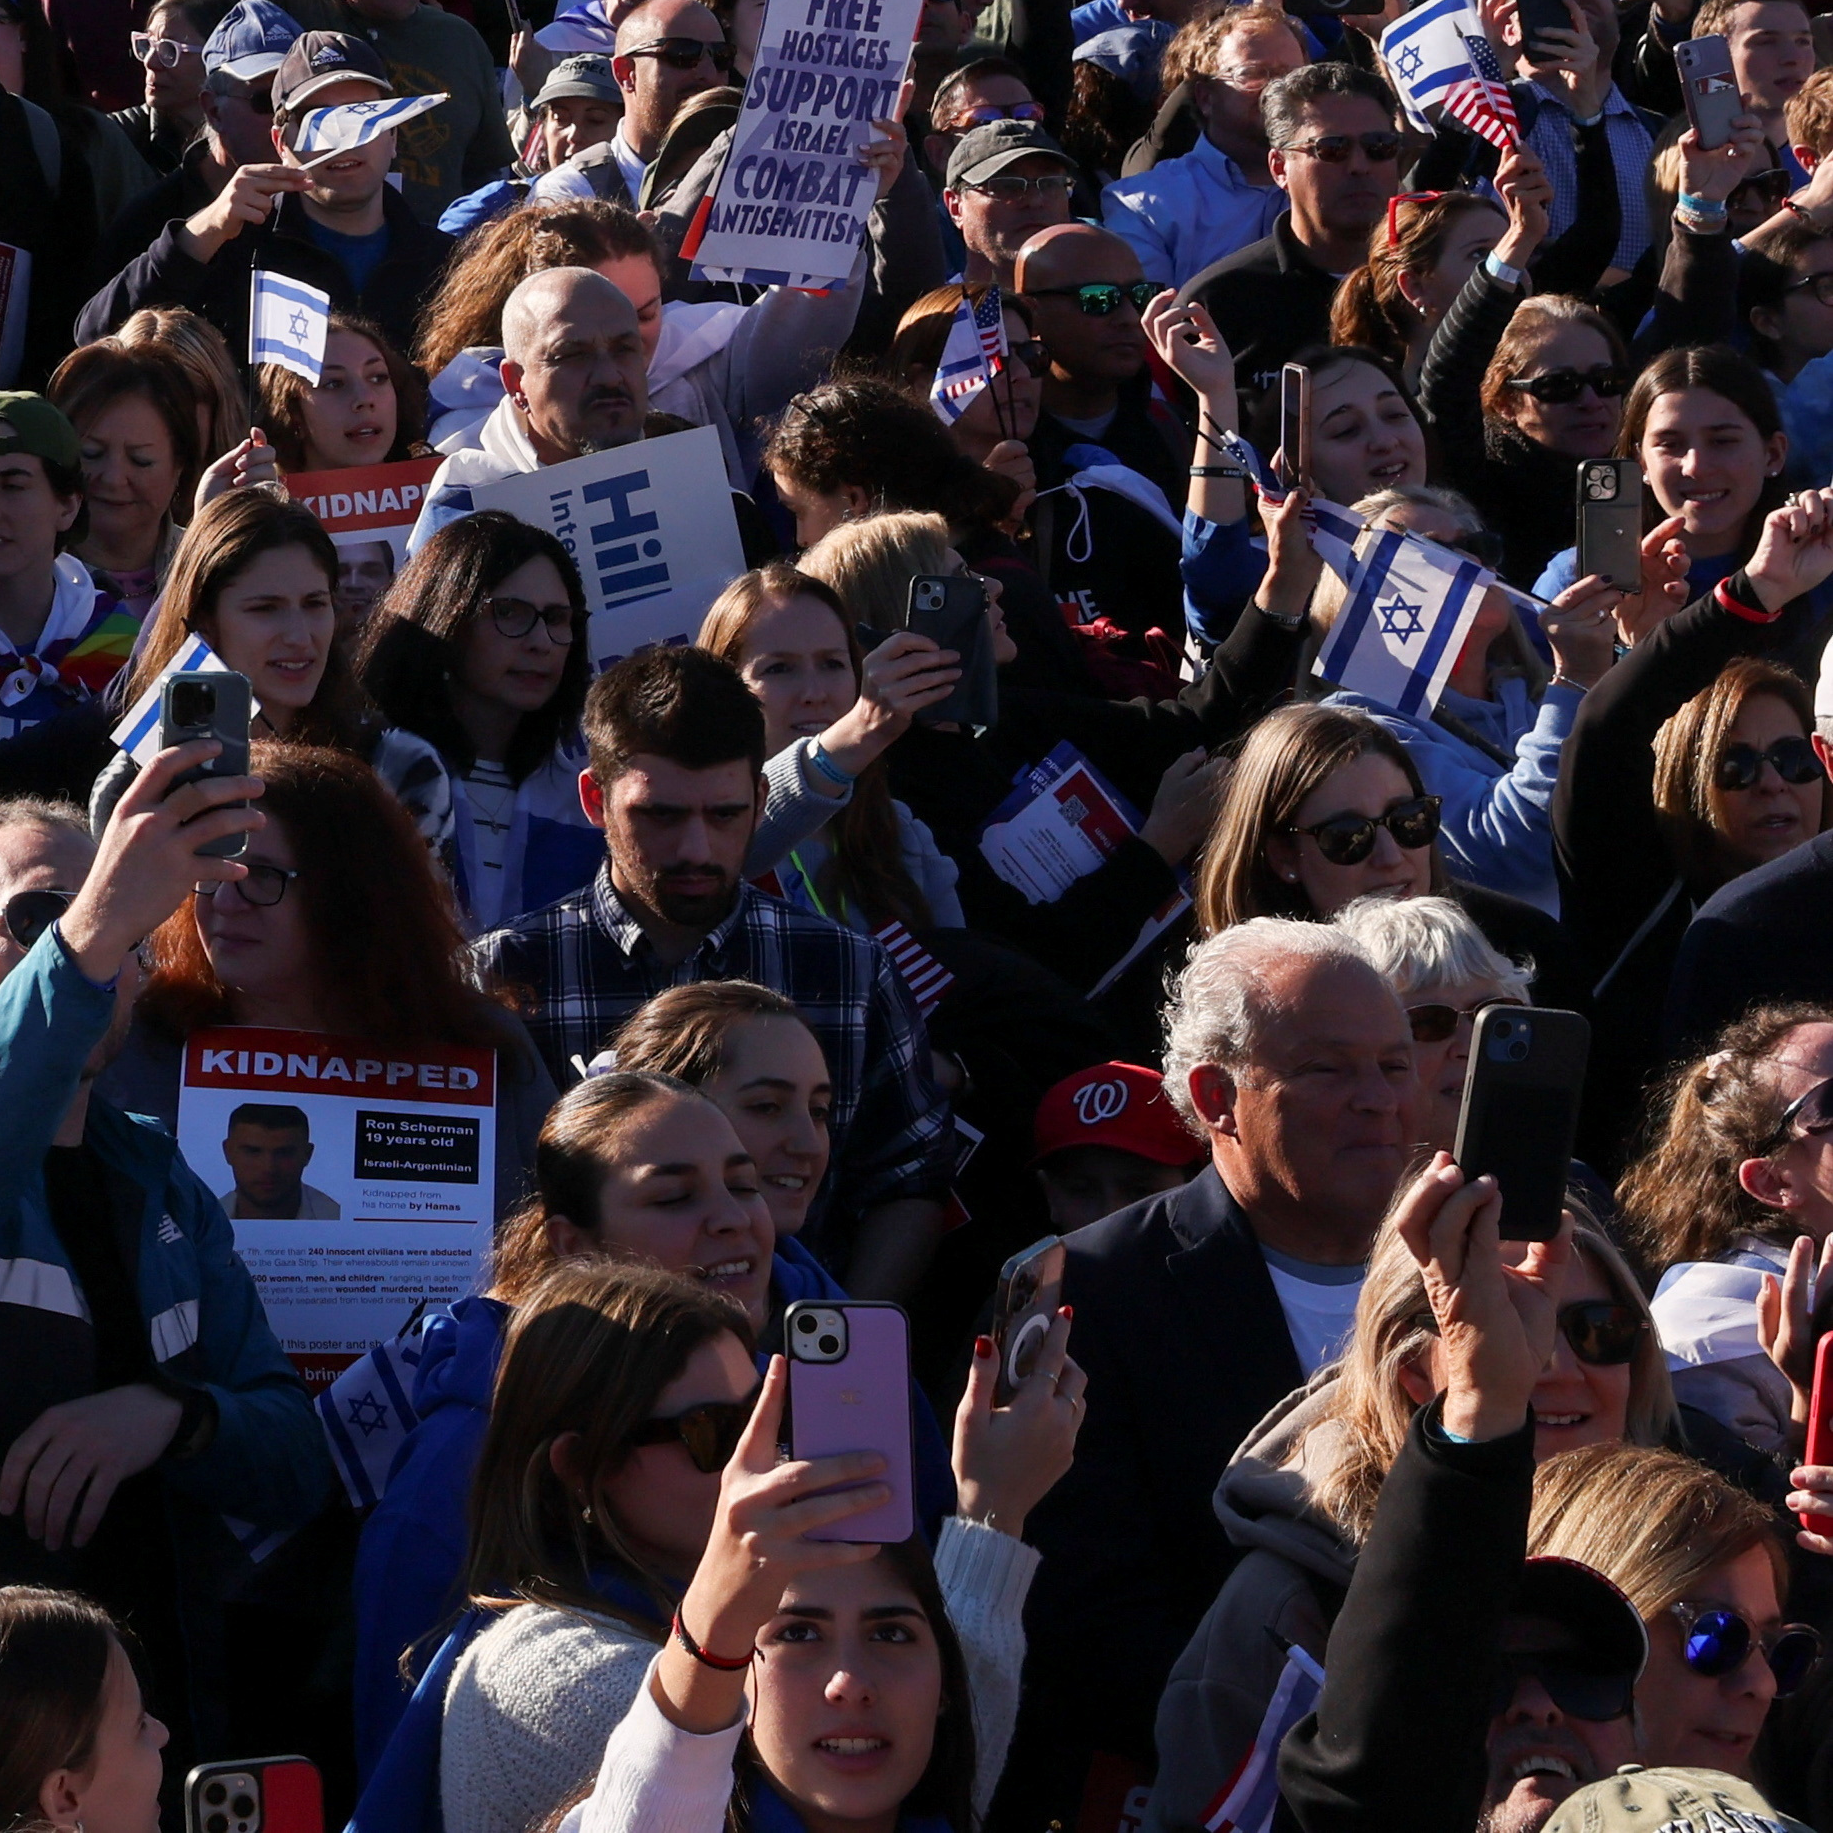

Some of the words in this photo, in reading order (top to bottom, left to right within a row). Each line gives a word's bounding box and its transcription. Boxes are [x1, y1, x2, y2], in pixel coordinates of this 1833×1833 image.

[264, 32, 294, 43] adidas
[779, 30, 890, 71] HOSTAGES
[310, 52, 346, 67] adidas
[746, 65, 900, 122] SUPPORT
[773, 119, 851, 156] ISRAEL
[734, 154, 869, 208] COMBAT
[707, 202, 868, 246] ANTISEMITISM
[201, 1049, 478, 1089] KIDNAPPED
[365, 1119, 396, 1131] Ron
[400, 1121, 474, 1136] Scherman
[365, 1132, 382, 1143] 19
[386, 1134, 426, 1147] years
[431, 1136, 454, 1148] old
[364, 1158, 472, 1173] Israeli-Argentinian
[362, 1189, 416, 1201] Kidnapped
[419, 1190, 441, 1200] from
[379, 1201, 407, 1210] home
[409, 1201, 422, 1212] by
[424, 1201, 461, 1212] Hamas
[308, 1247, 324, 1256] 240
[326, 1247, 365, 1257] innocent
[367, 1247, 404, 1257] civilians
[406, 1249, 428, 1257] were
[430, 1247, 472, 1257] abducted
[309, 1340, 343, 1351] poster
[345, 1339, 366, 1350] and
